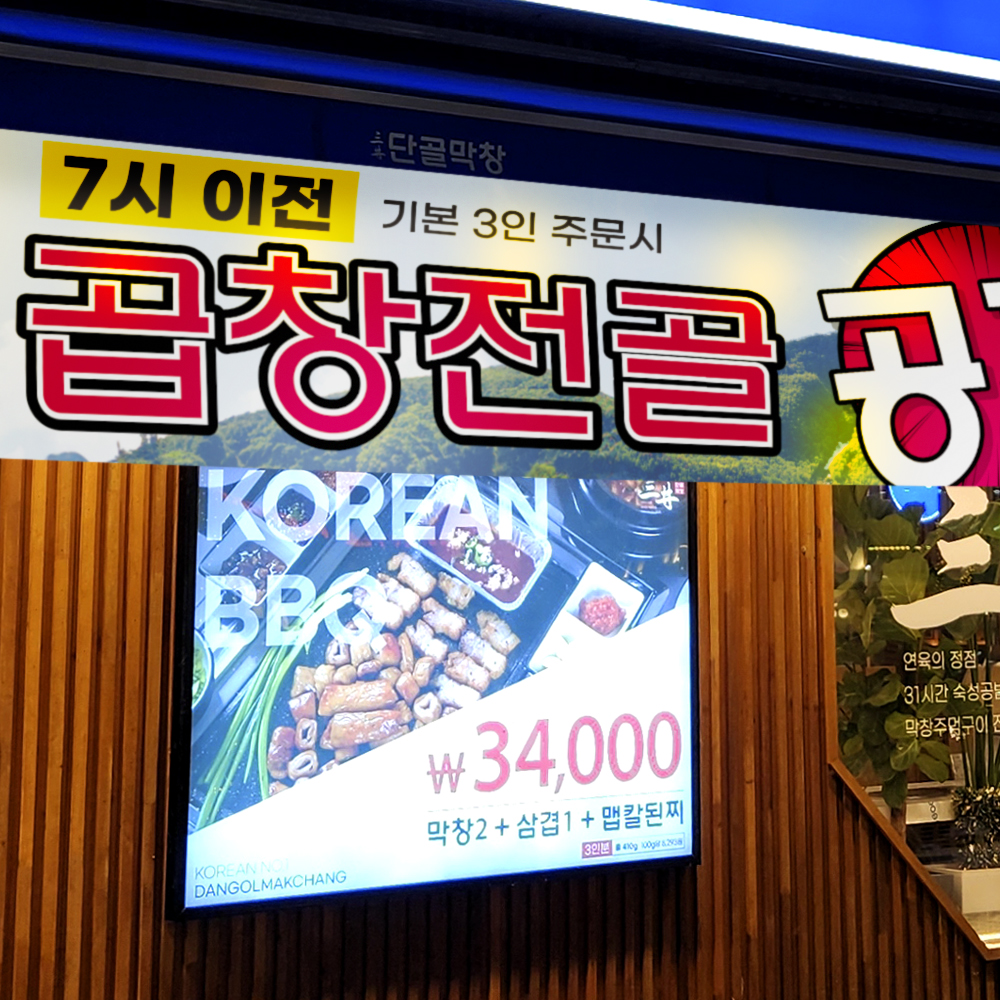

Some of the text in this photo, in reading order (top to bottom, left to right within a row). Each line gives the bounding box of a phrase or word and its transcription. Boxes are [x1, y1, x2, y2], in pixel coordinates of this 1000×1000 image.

[388, 132, 506, 175] 단골막창
[62, 155, 334, 232] 7시 이전
[382, 199, 664, 254] 기본 3인 주문시
[16, 234, 784, 456] 곱창전골
[206, 469, 548, 541] KOREAN
[204, 572, 386, 650] BBQ
[903, 650, 977, 672] 연육의 정점
[904, 684, 948, 705] 31시간
[428, 818, 487, 847] 막창2
[517, 811, 572, 839] 삼겹1
[195, 858, 289, 880] KOREAN NO.1
[195, 870, 347, 899] DANGOLMAKCHANG
